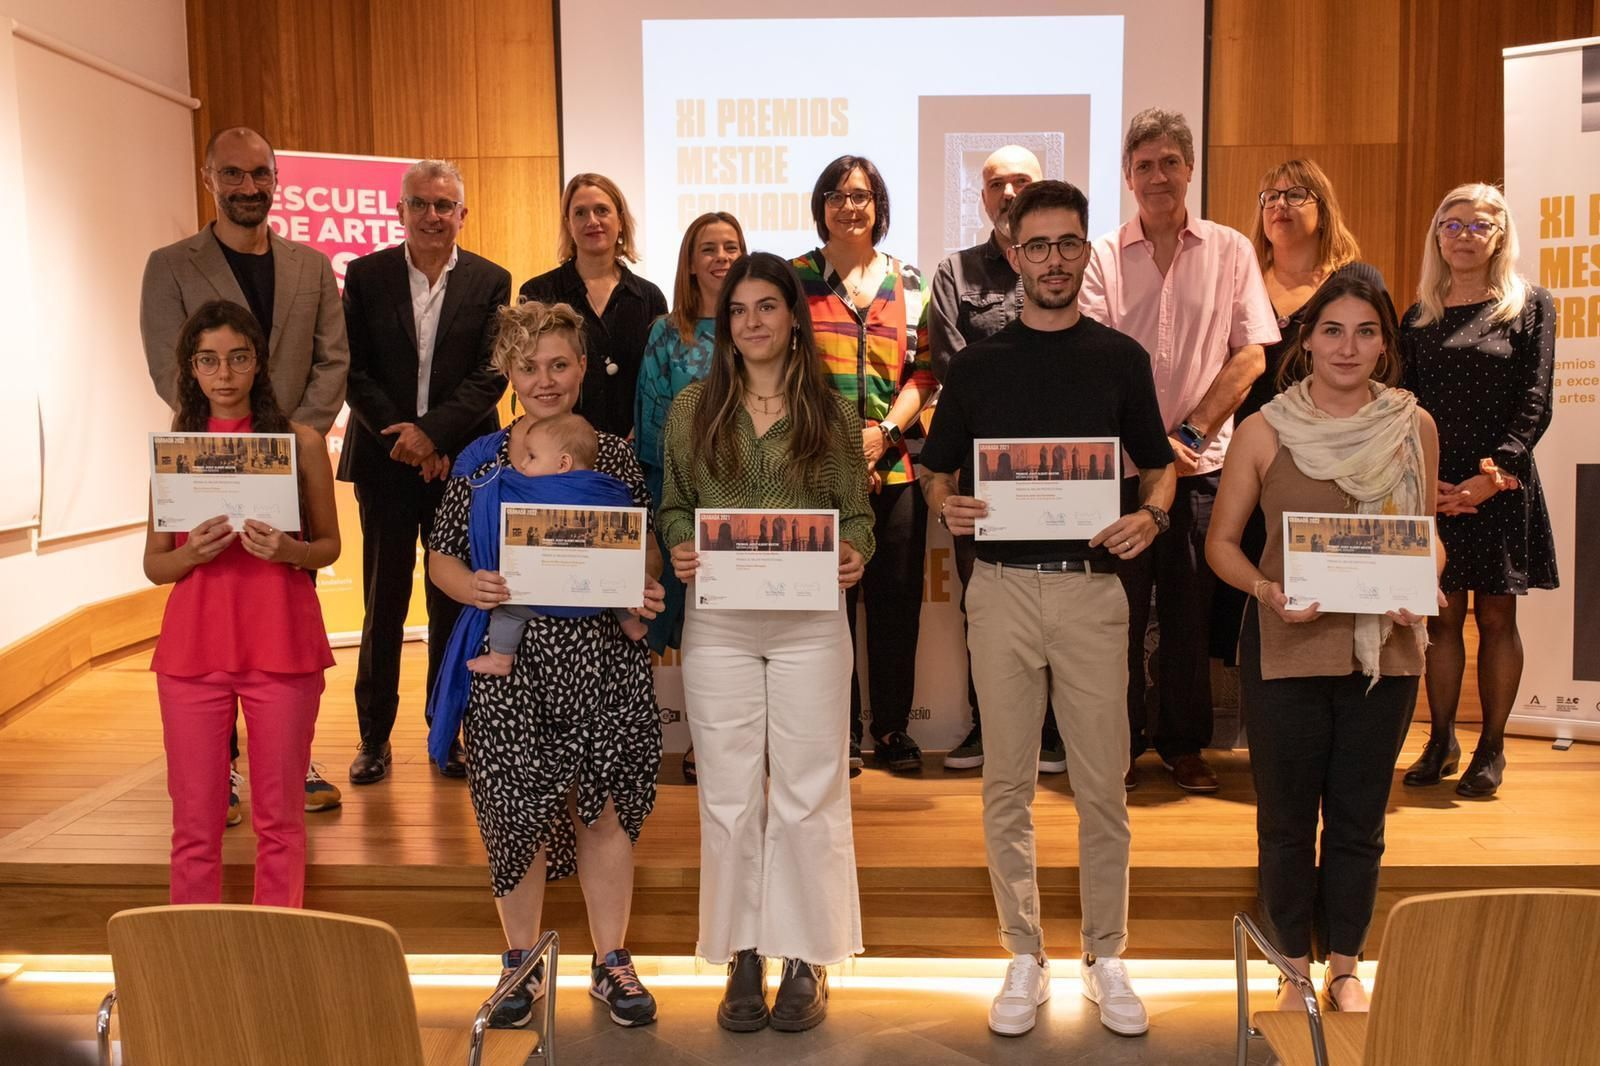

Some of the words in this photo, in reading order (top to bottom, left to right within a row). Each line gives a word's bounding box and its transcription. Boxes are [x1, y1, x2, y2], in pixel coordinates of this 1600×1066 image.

[676, 98, 705, 138] XI
[717, 97, 849, 138] PREMIOS
[677, 145, 789, 185] MESTRE
[271, 184, 399, 216] ESCUEL
[268, 215, 310, 242] DE
